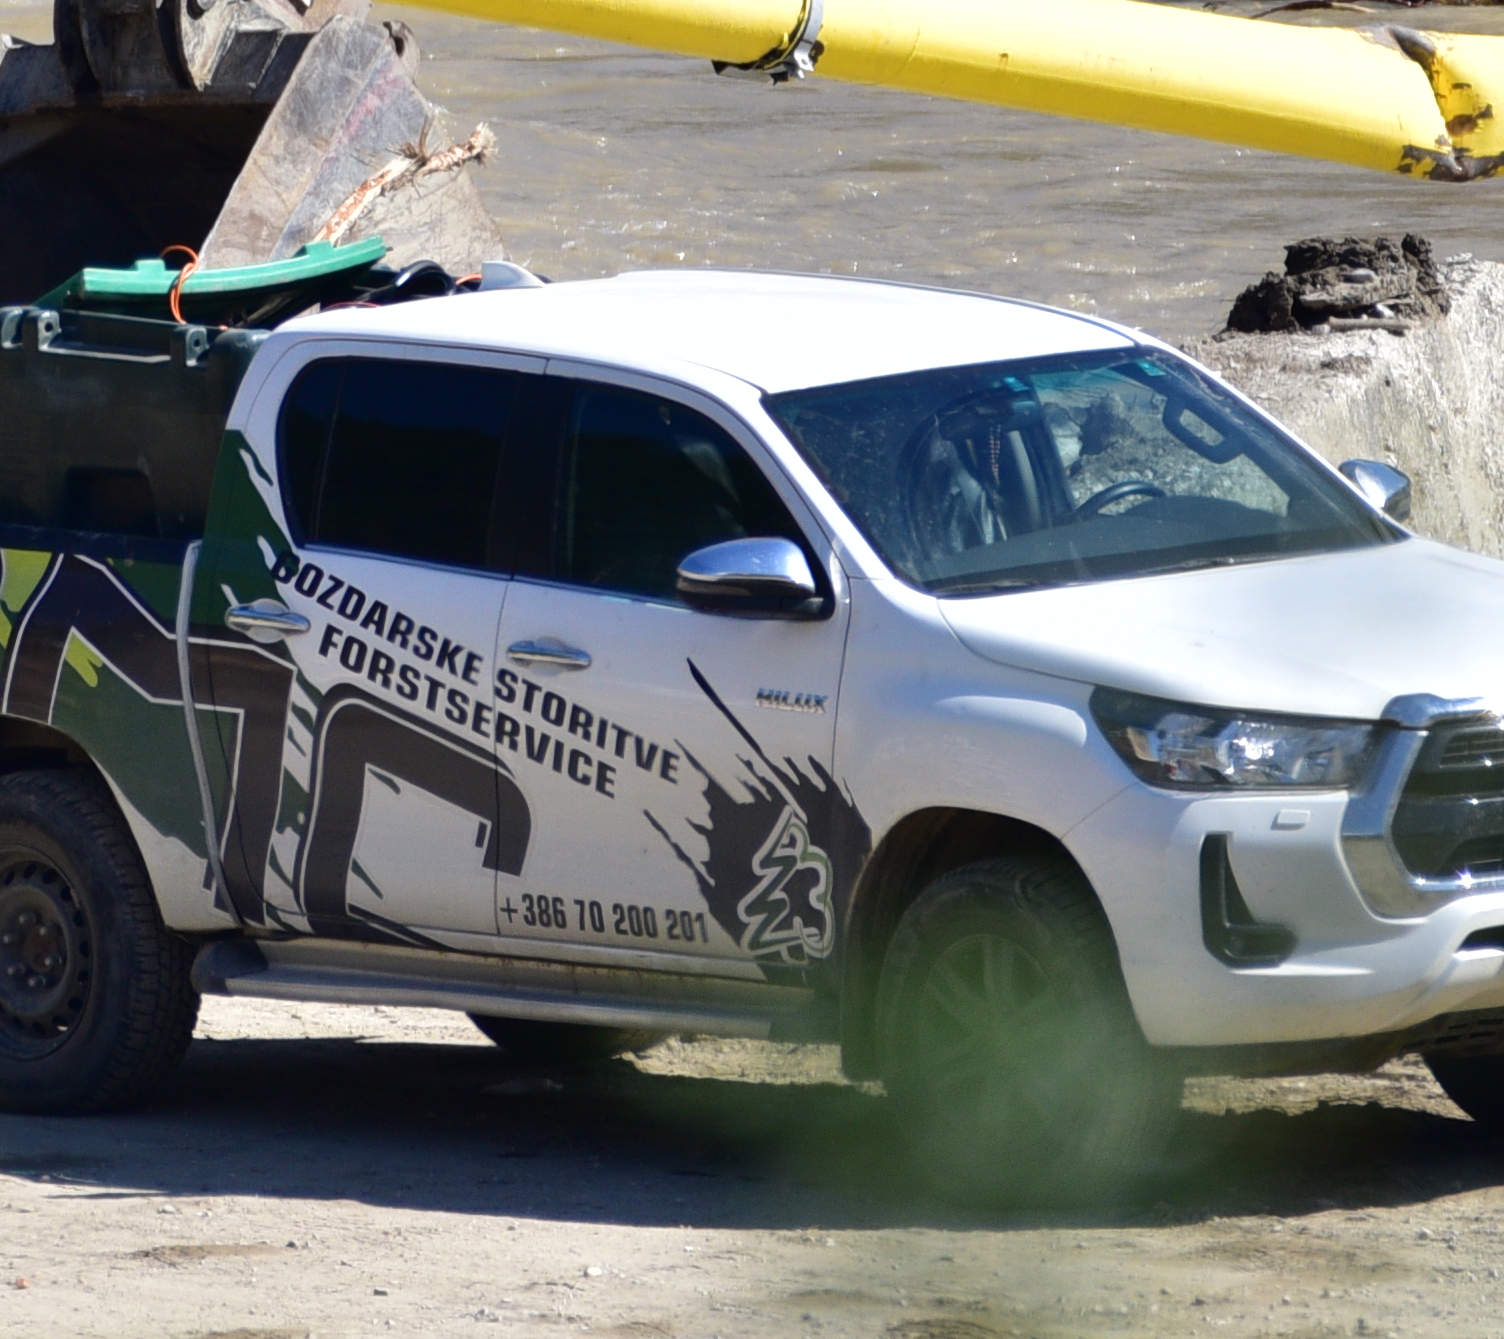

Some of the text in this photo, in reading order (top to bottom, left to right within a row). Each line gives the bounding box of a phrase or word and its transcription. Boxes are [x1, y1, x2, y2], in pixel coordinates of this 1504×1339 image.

[318, 623, 617, 799] FORSTSERVICE
[494, 668, 681, 785] STORITVE
[754, 687, 829, 714] HILUX
[499, 893, 709, 943] +386 70 200 201
